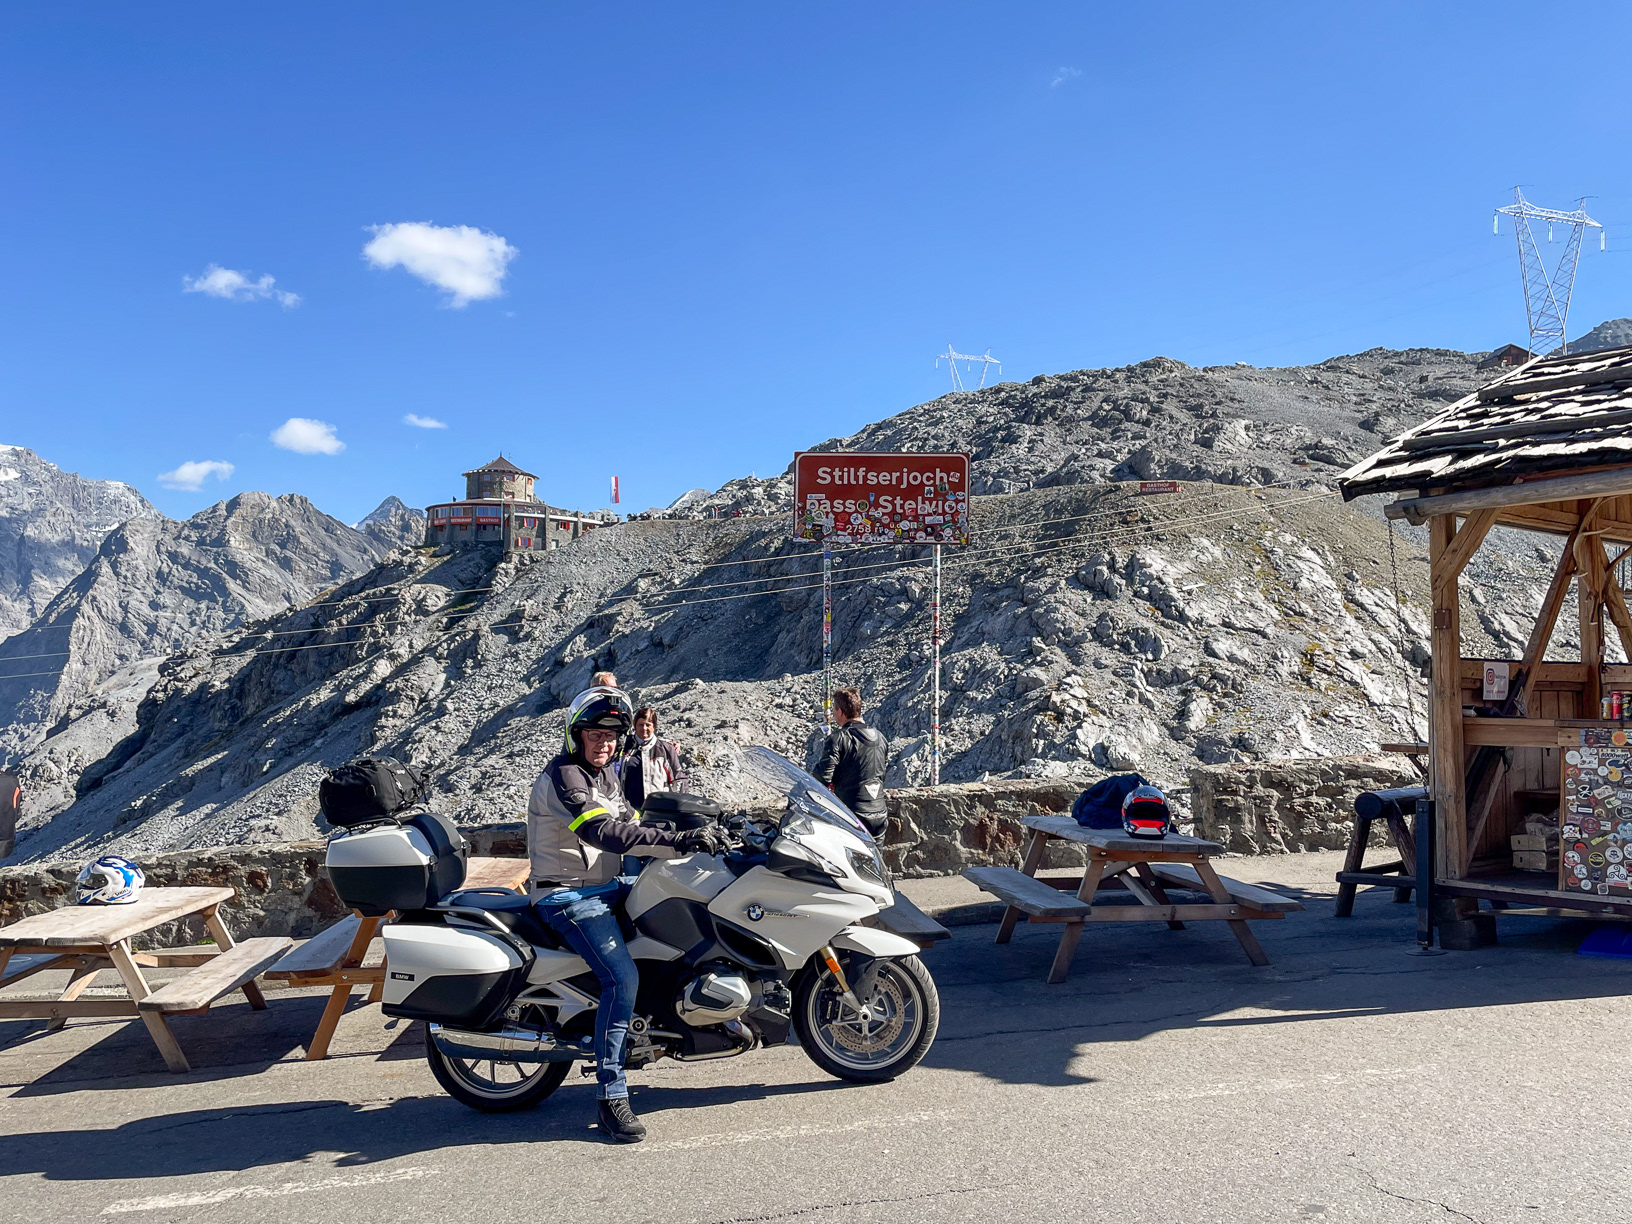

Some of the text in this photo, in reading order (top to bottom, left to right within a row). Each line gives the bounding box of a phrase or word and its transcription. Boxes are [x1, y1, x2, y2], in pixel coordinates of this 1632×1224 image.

[816, 467, 948, 489] Stilfserjoch
[878, 495, 956, 514] Stelvi
[845, 524, 872, 533] 2758
